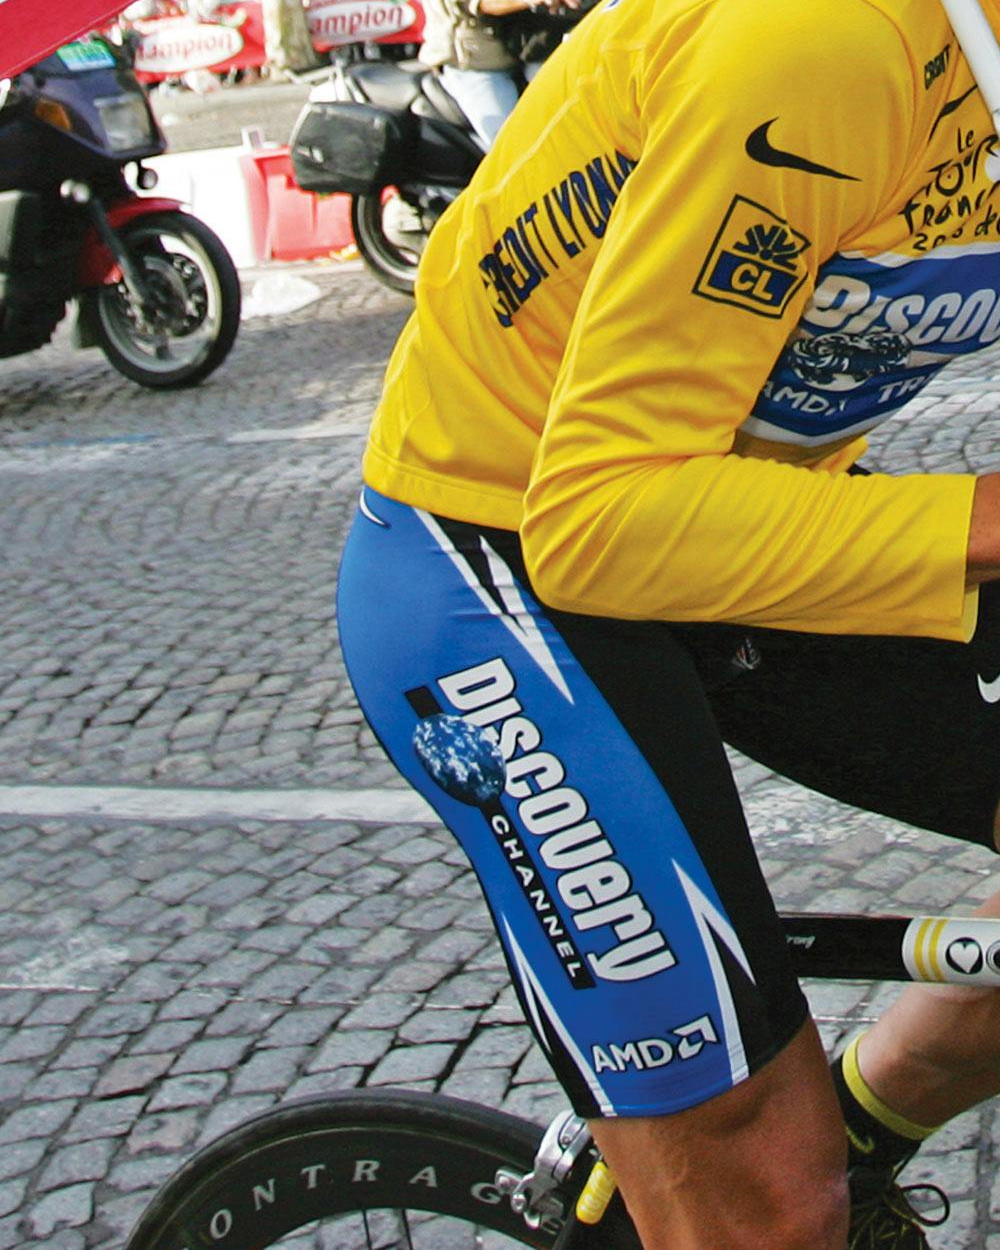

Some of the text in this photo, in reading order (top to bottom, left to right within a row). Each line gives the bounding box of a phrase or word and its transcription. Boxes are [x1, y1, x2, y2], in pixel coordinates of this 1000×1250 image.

[309, 5, 405, 37] ampion
[137, 32, 234, 61] ampion
[730, 262, 775, 302] CL
[490, 814, 586, 979] CHANNEL
[591, 1037, 674, 1074] AMD
[188, 1158, 501, 1250] ONTRAG
